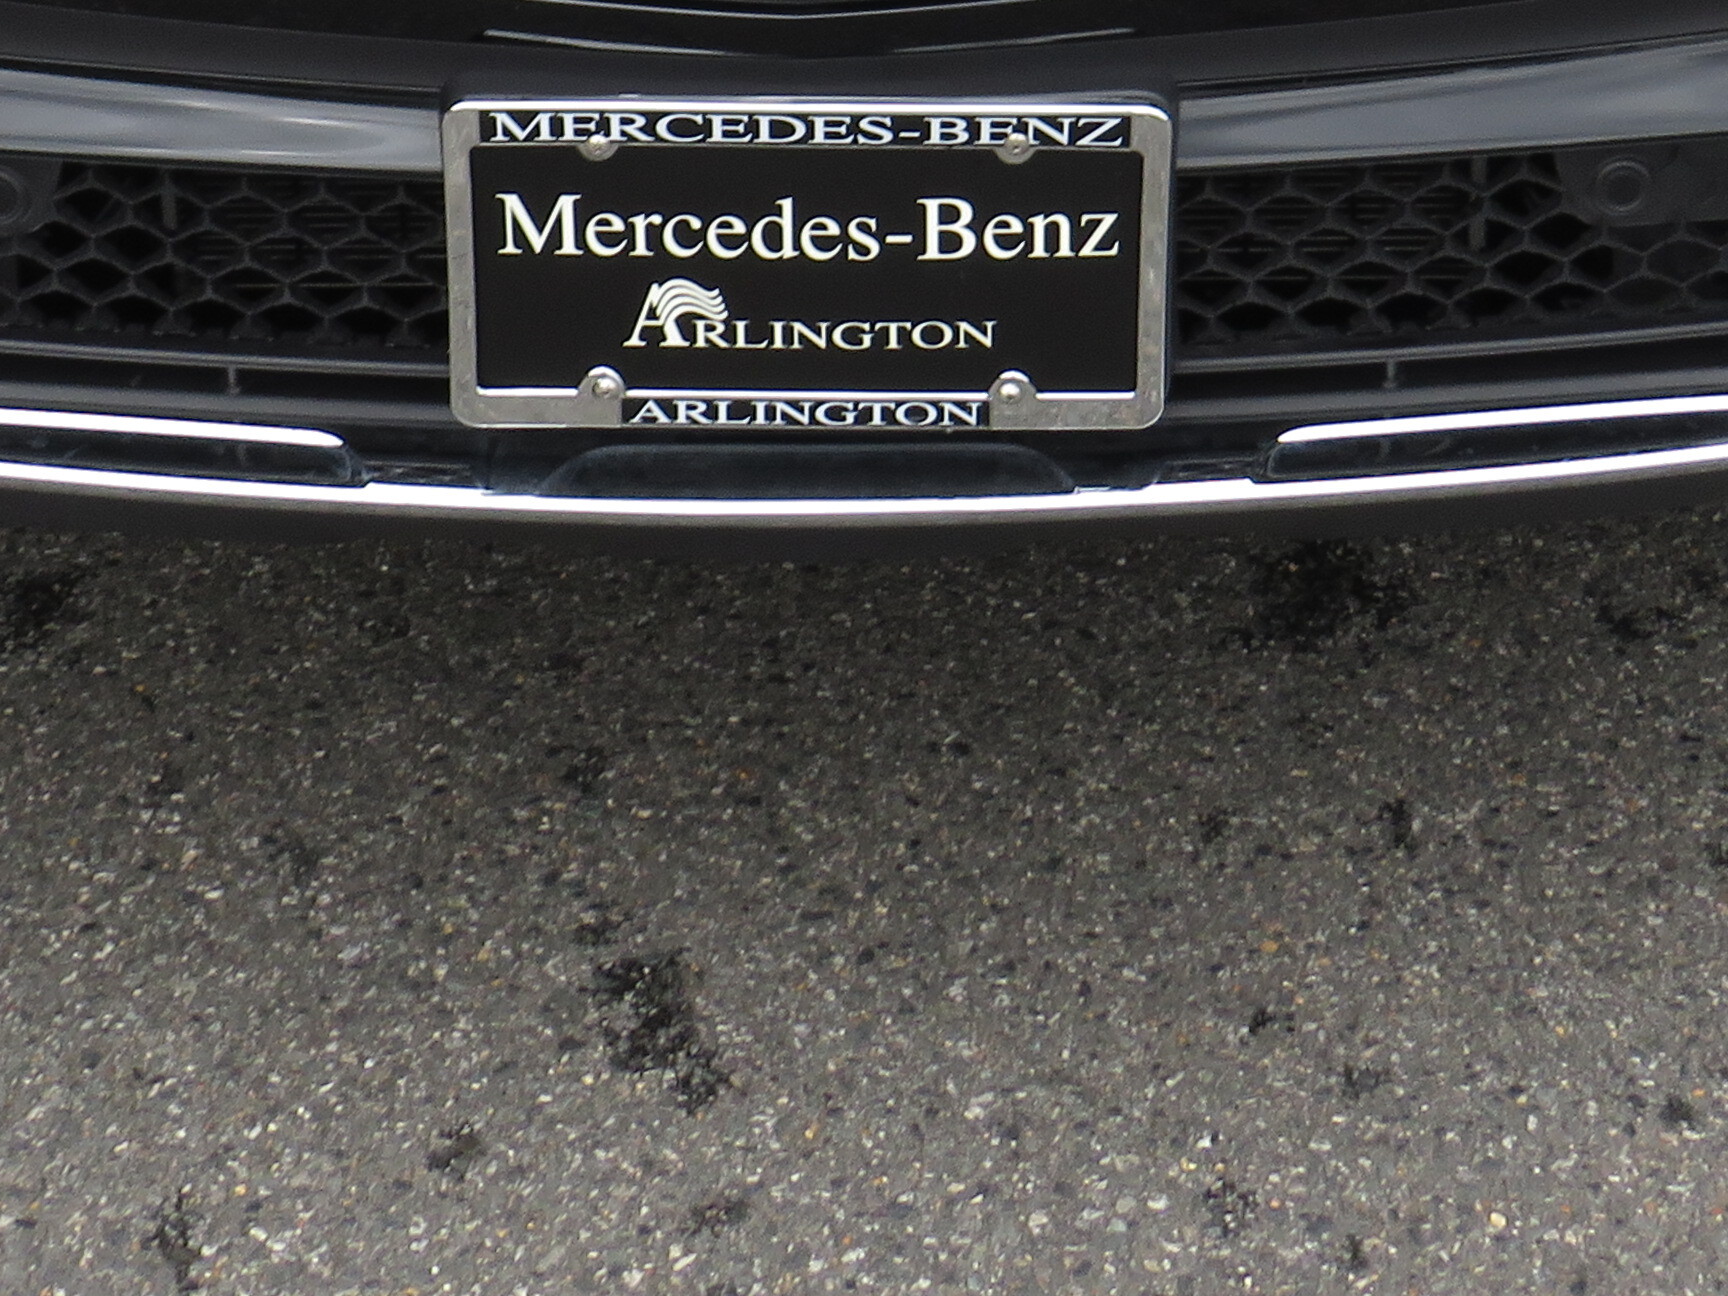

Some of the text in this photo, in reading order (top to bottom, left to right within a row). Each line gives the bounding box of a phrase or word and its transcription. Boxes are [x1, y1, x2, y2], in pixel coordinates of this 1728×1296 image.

[488, 111, 1124, 147] MERCEDES-BENZ
[495, 192, 1120, 261] Mercedes-Benz
[629, 399, 983, 426] ARLINGTON
